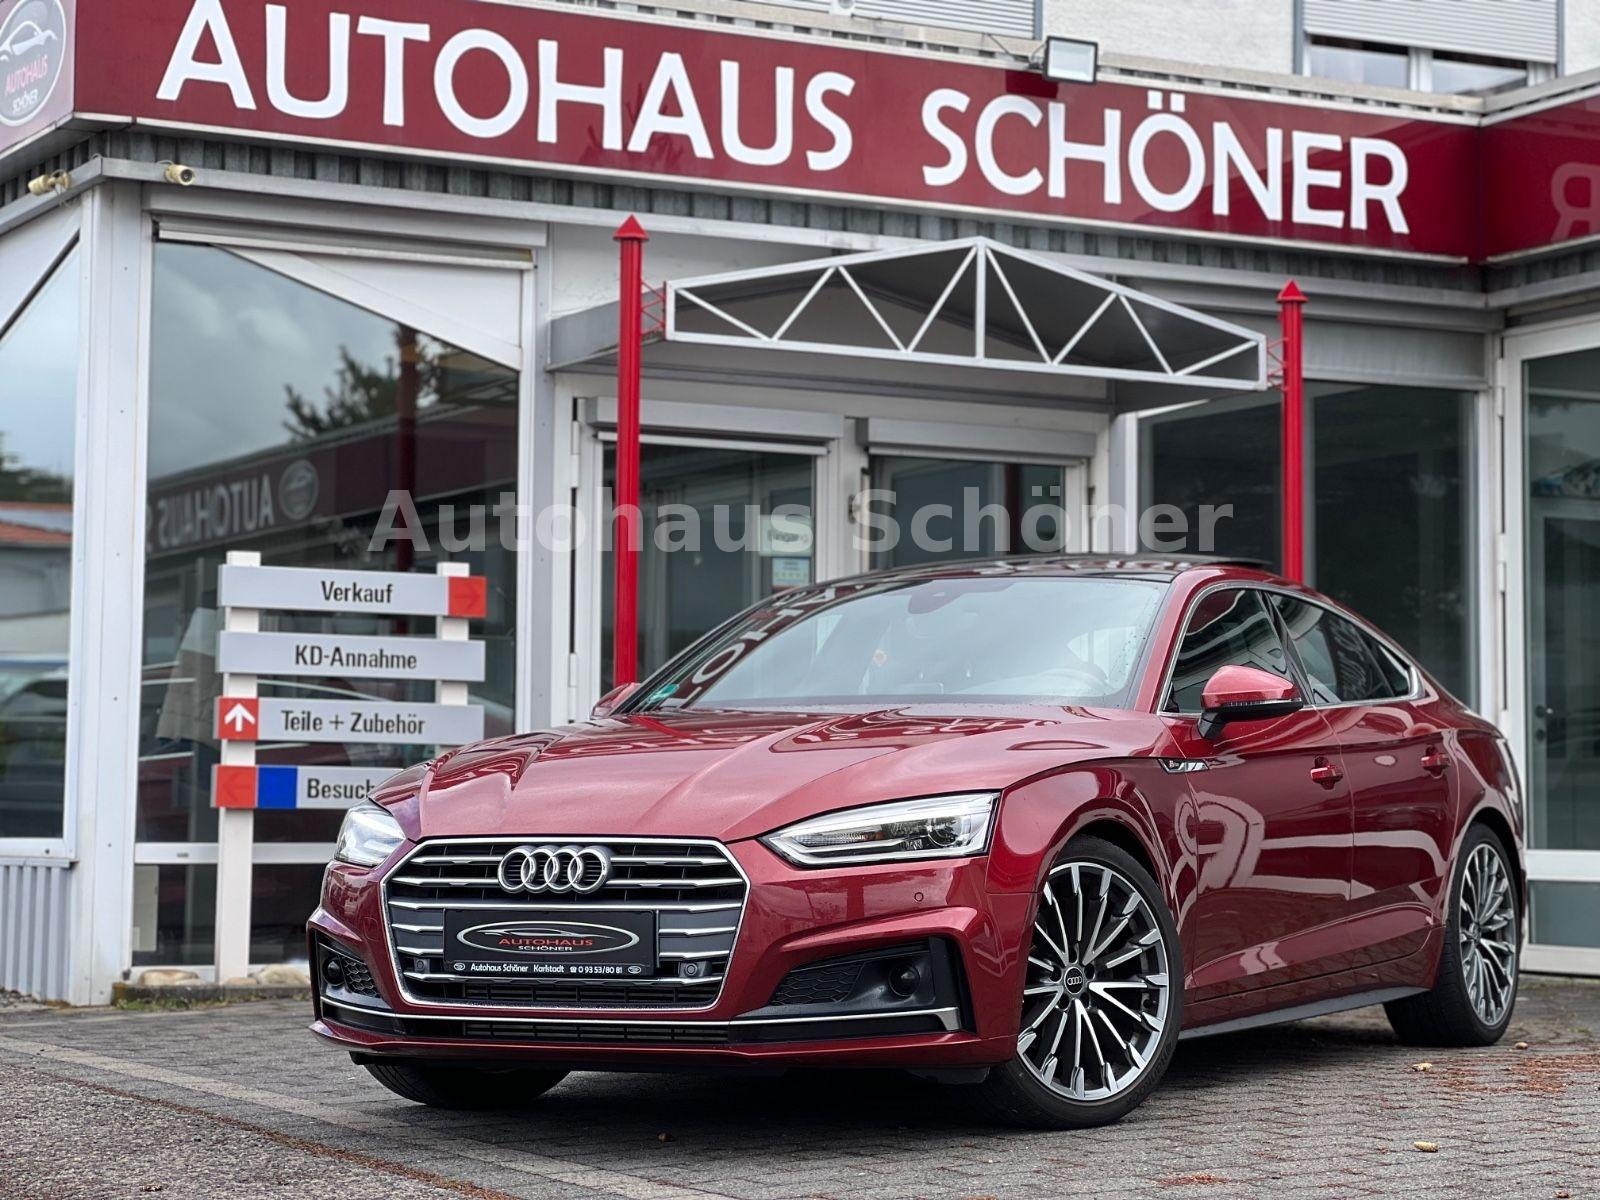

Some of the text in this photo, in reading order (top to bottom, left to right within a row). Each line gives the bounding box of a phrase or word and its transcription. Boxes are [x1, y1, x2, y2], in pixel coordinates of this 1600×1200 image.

[5, 54, 48, 96] AUTOHAUS
[156, 0, 1410, 235] AUTOHAUS SCHÖNER
[321, 580, 393, 604] Verkauf
[295, 644, 417, 670] KD-Annahme
[281, 710, 425, 735] Teile + Zubehör
[499, 938, 593, 946] AUTOHAUS
[470, 963, 502, 972] Autohaus
[502, 963, 529, 972] Schöner
[533, 964, 565, 973] Karlstadt
